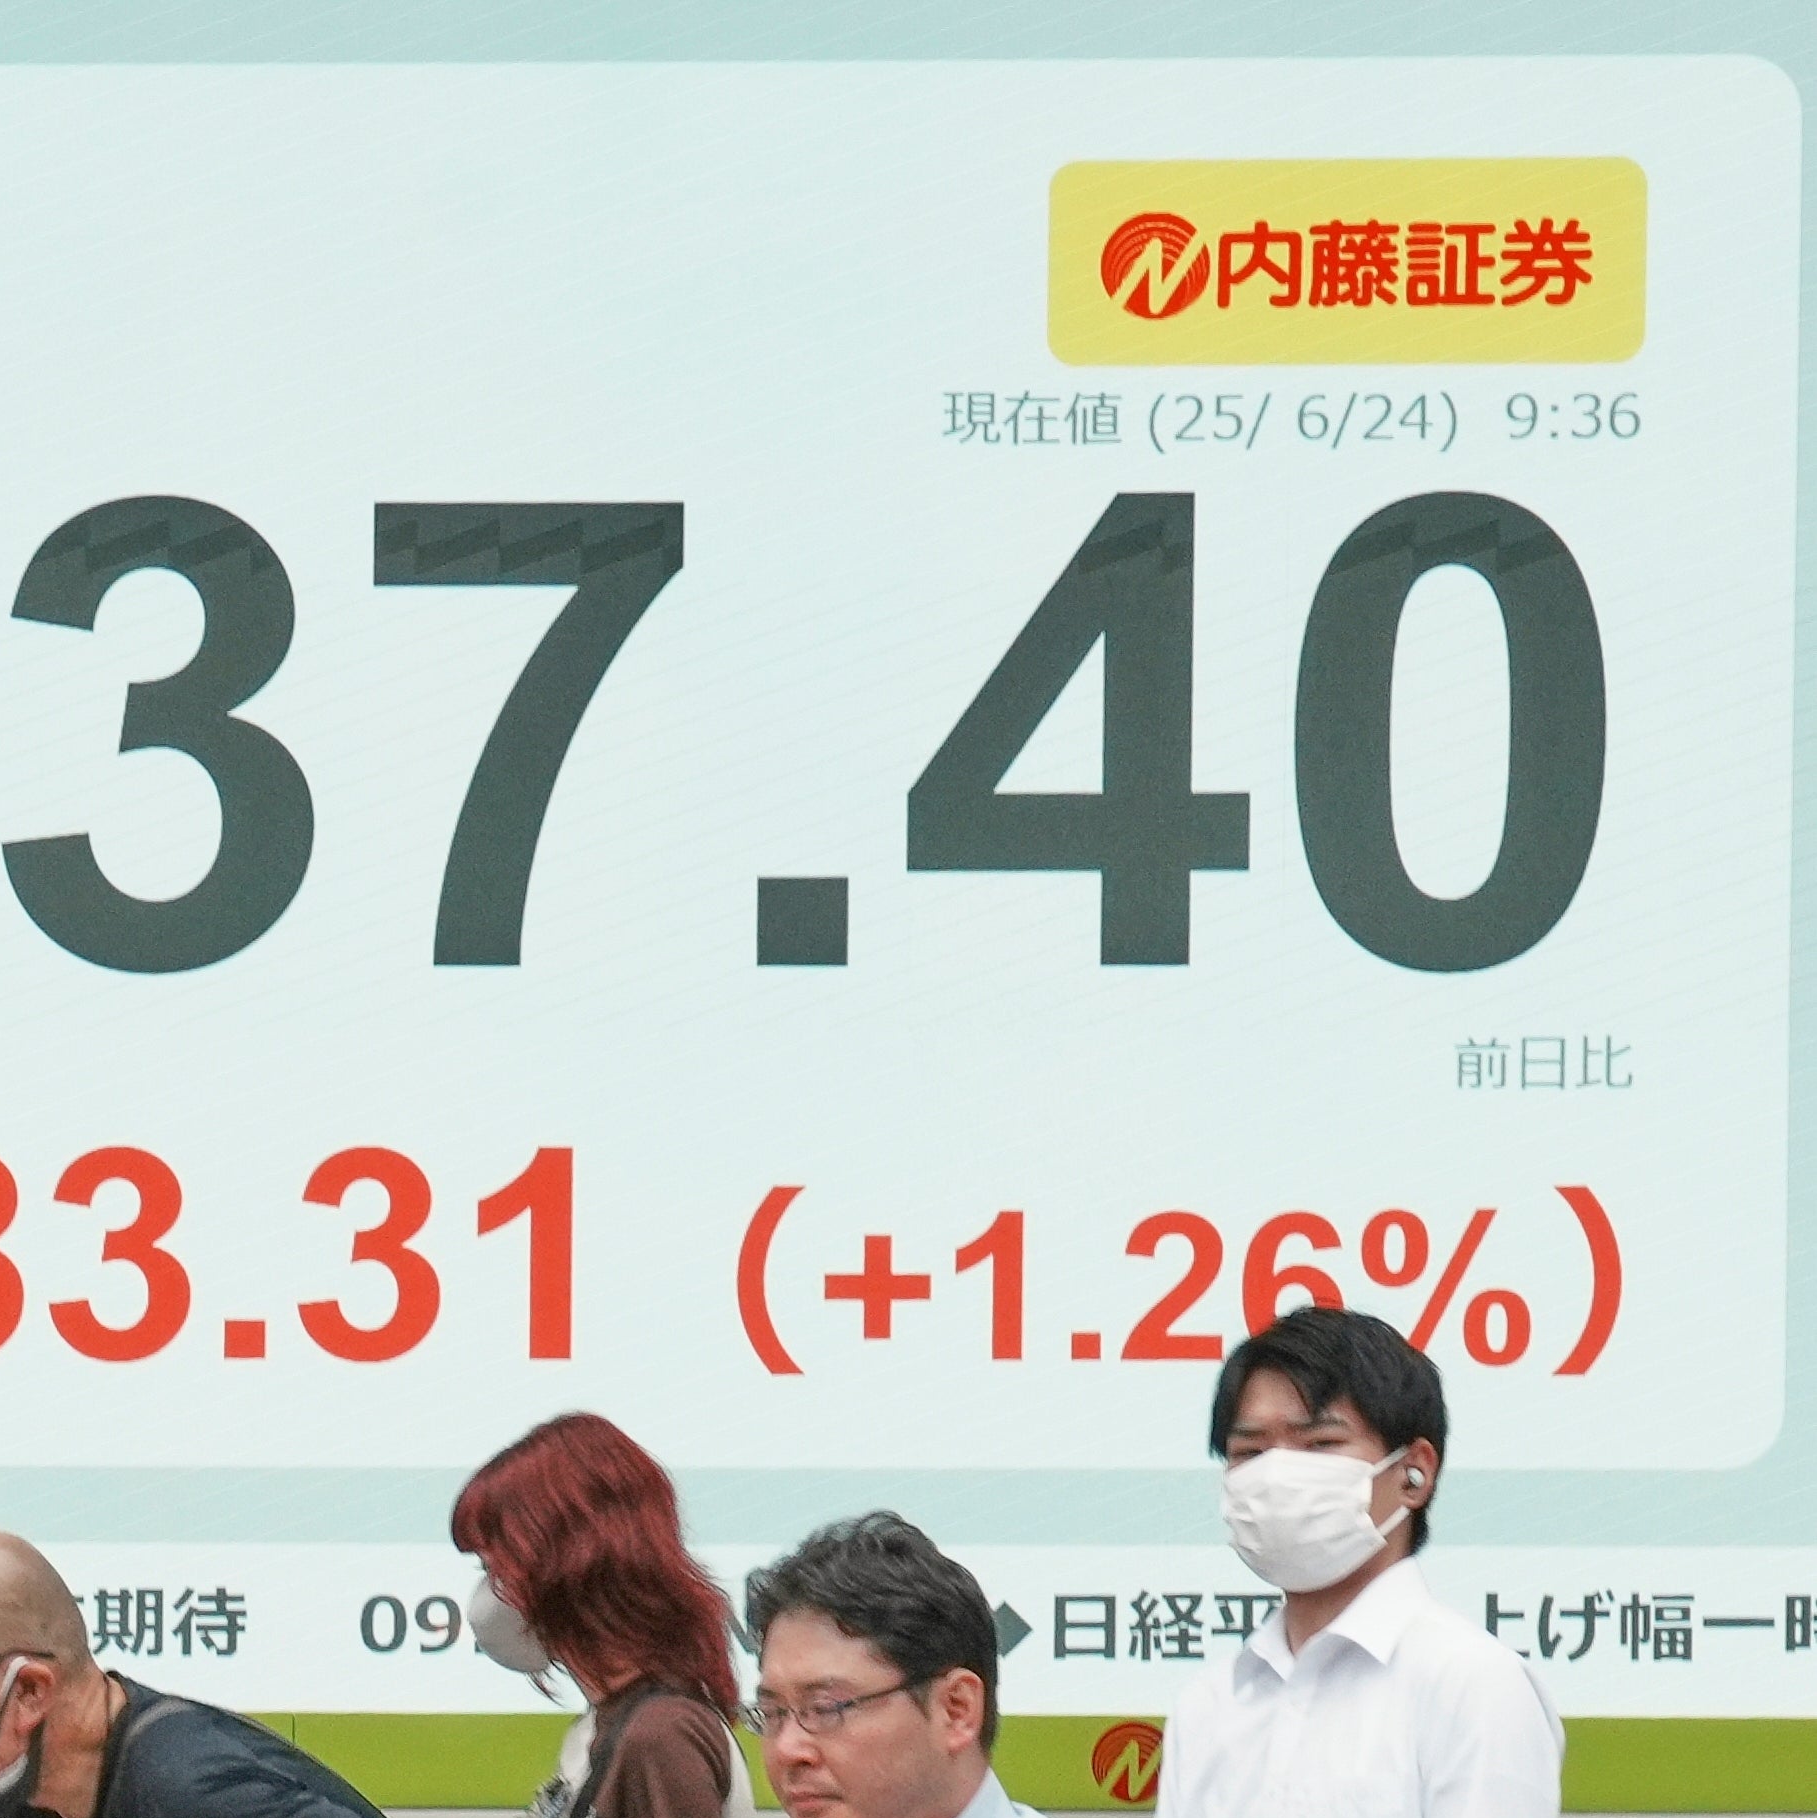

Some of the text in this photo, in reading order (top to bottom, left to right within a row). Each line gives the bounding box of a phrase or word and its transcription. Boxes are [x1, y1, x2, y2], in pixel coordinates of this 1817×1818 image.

[1217, 219, 1594, 309] 内藤証券
[943, 391, 1643, 454] 現在値 (25/ 6/24) 9:36
[1455, 1036, 1635, 1092] 前日比
[73, 1587, 249, 1657] 期待
